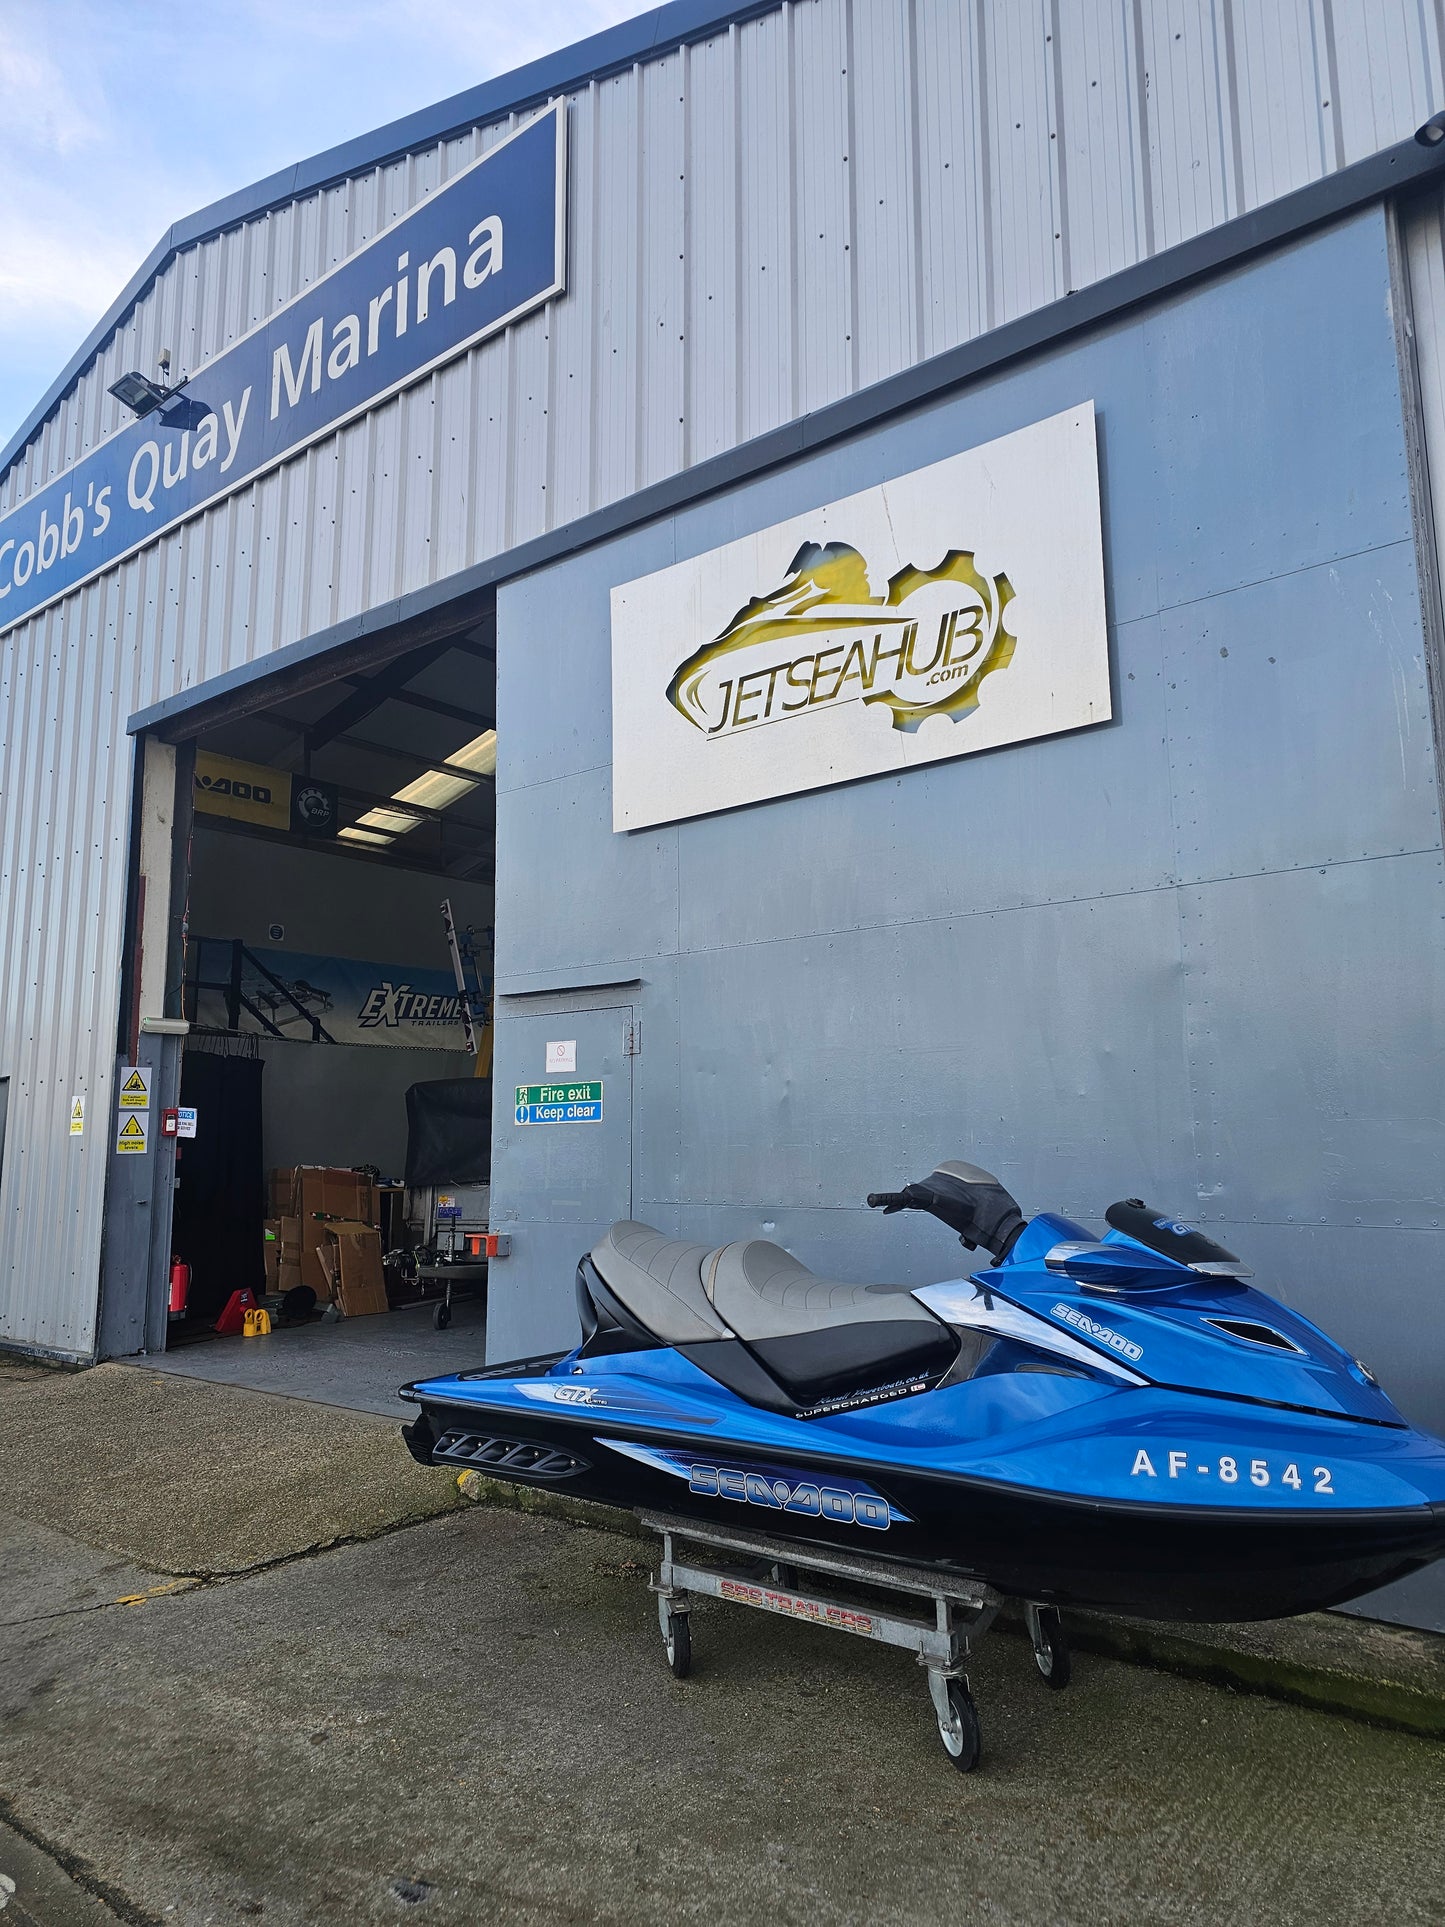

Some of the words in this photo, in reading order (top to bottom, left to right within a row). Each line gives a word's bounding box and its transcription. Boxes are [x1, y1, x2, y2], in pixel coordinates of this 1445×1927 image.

[0, 481, 111, 598] Cobb's
[128, 386, 252, 513] Quay
[270, 215, 503, 421] Marina
[708, 605, 984, 734] JETSEAHUB
[926, 661, 969, 687] .com
[311, 807, 330, 817] BRP
[540, 1087, 564, 1102] Fire
[568, 1085, 591, 1100] exit
[178, 1111, 193, 1119] OTICE
[536, 1106, 564, 1121] Keep
[567, 1104, 595, 1117] clear
[554, 1385, 599, 1404] GTX
[795, 1388, 907, 1419] SUPERCHARGED
